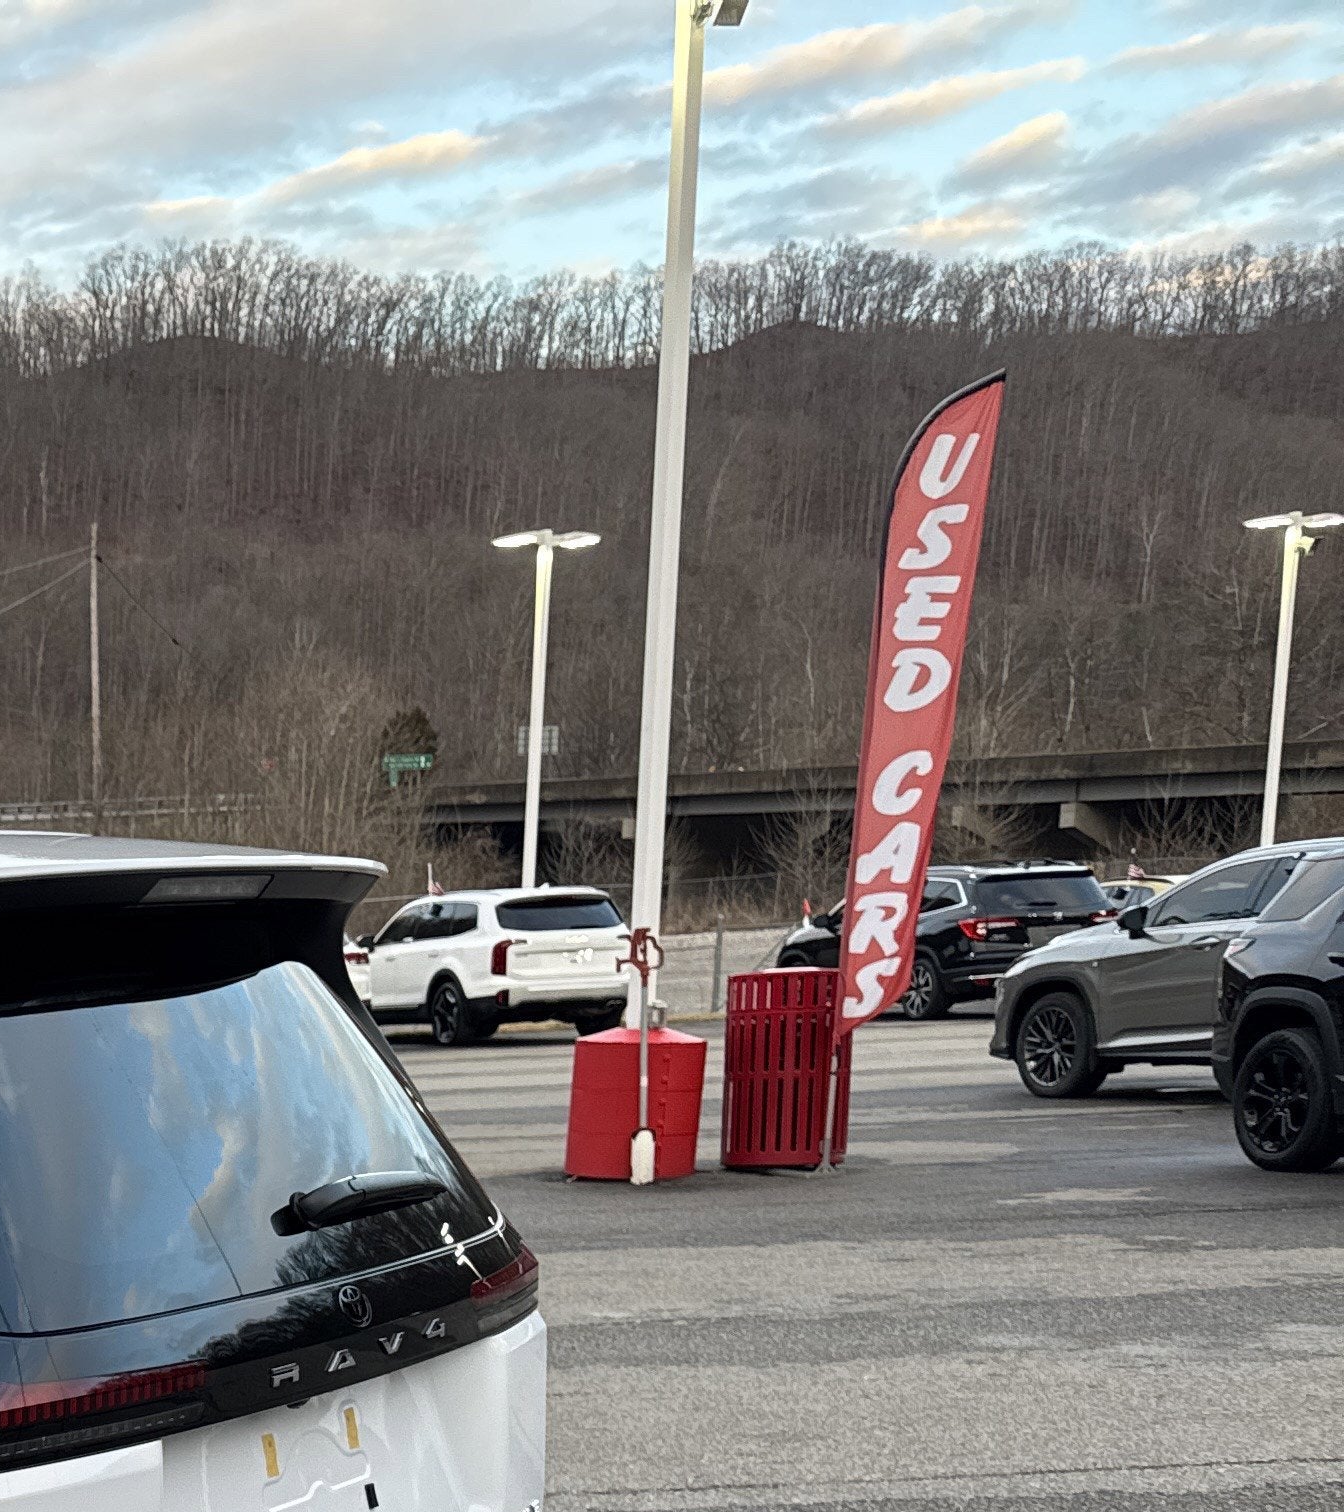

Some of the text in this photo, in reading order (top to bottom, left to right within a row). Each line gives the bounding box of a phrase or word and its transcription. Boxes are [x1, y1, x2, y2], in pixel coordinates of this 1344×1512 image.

[842, 432, 980, 1019] USED CARS
[270, 1317, 446, 1388] RAV4
